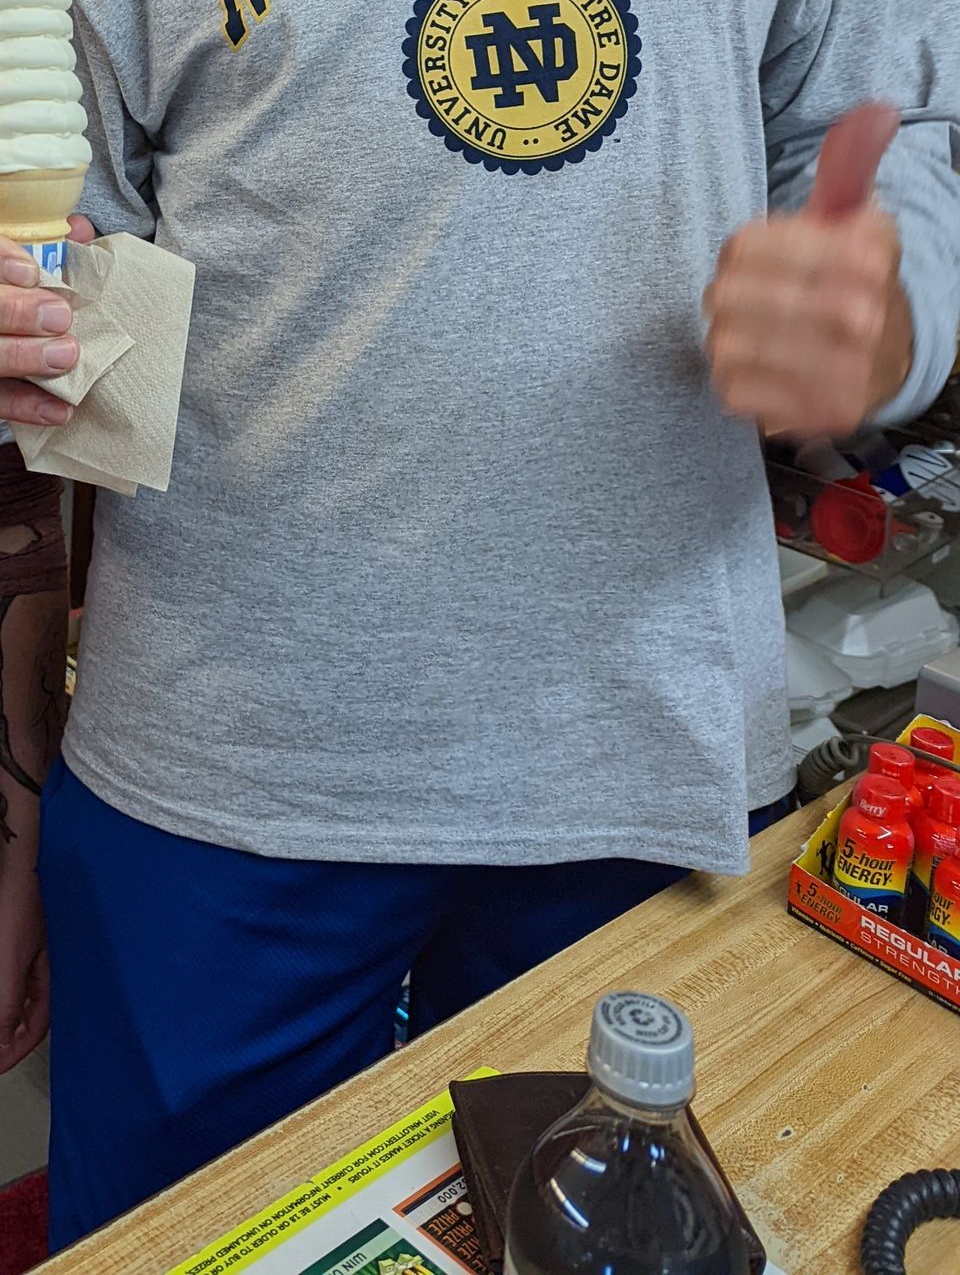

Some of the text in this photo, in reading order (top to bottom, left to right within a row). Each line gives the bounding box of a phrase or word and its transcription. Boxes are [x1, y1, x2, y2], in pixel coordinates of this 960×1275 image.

[554, 61, 621, 143] DAME
[859, 799, 887, 817] Berry
[842, 837, 896, 871] 5-hour
[837, 857, 892, 885] ENERGY
[801, 894, 841, 924] ENERGY
[420, 1107, 439, 1123] VISIT
[366, 1118, 422, 1158] MNLOTTERY.COM
[401, 1129, 426, 1149] TICKET
[352, 1154, 368, 1168] FOR
[378, 1144, 403, 1164] MAKES
[319, 1164, 354, 1189] CURRENT
[347, 1164, 373, 1184] YOURS
[271, 1185, 322, 1221] INFORMATION
[308, 1191, 331, 1210] MUST
[288, 1212, 301, 1224] 18
[297, 1205, 311, 1217] BE
[258, 1217, 273, 1230] ON
[275, 1218, 290, 1232] OR
[427, 1209, 459, 1236] PRIZE
[215, 1225, 260, 1259] UNCLAIMED
[250, 1226, 279, 1249] OLDER
[443, 1221, 474, 1247] PRIZE
[222, 1251, 241, 1267] BUY
[238, 1244, 253, 1257] TO
[340, 1250, 368, 1273] WIN
